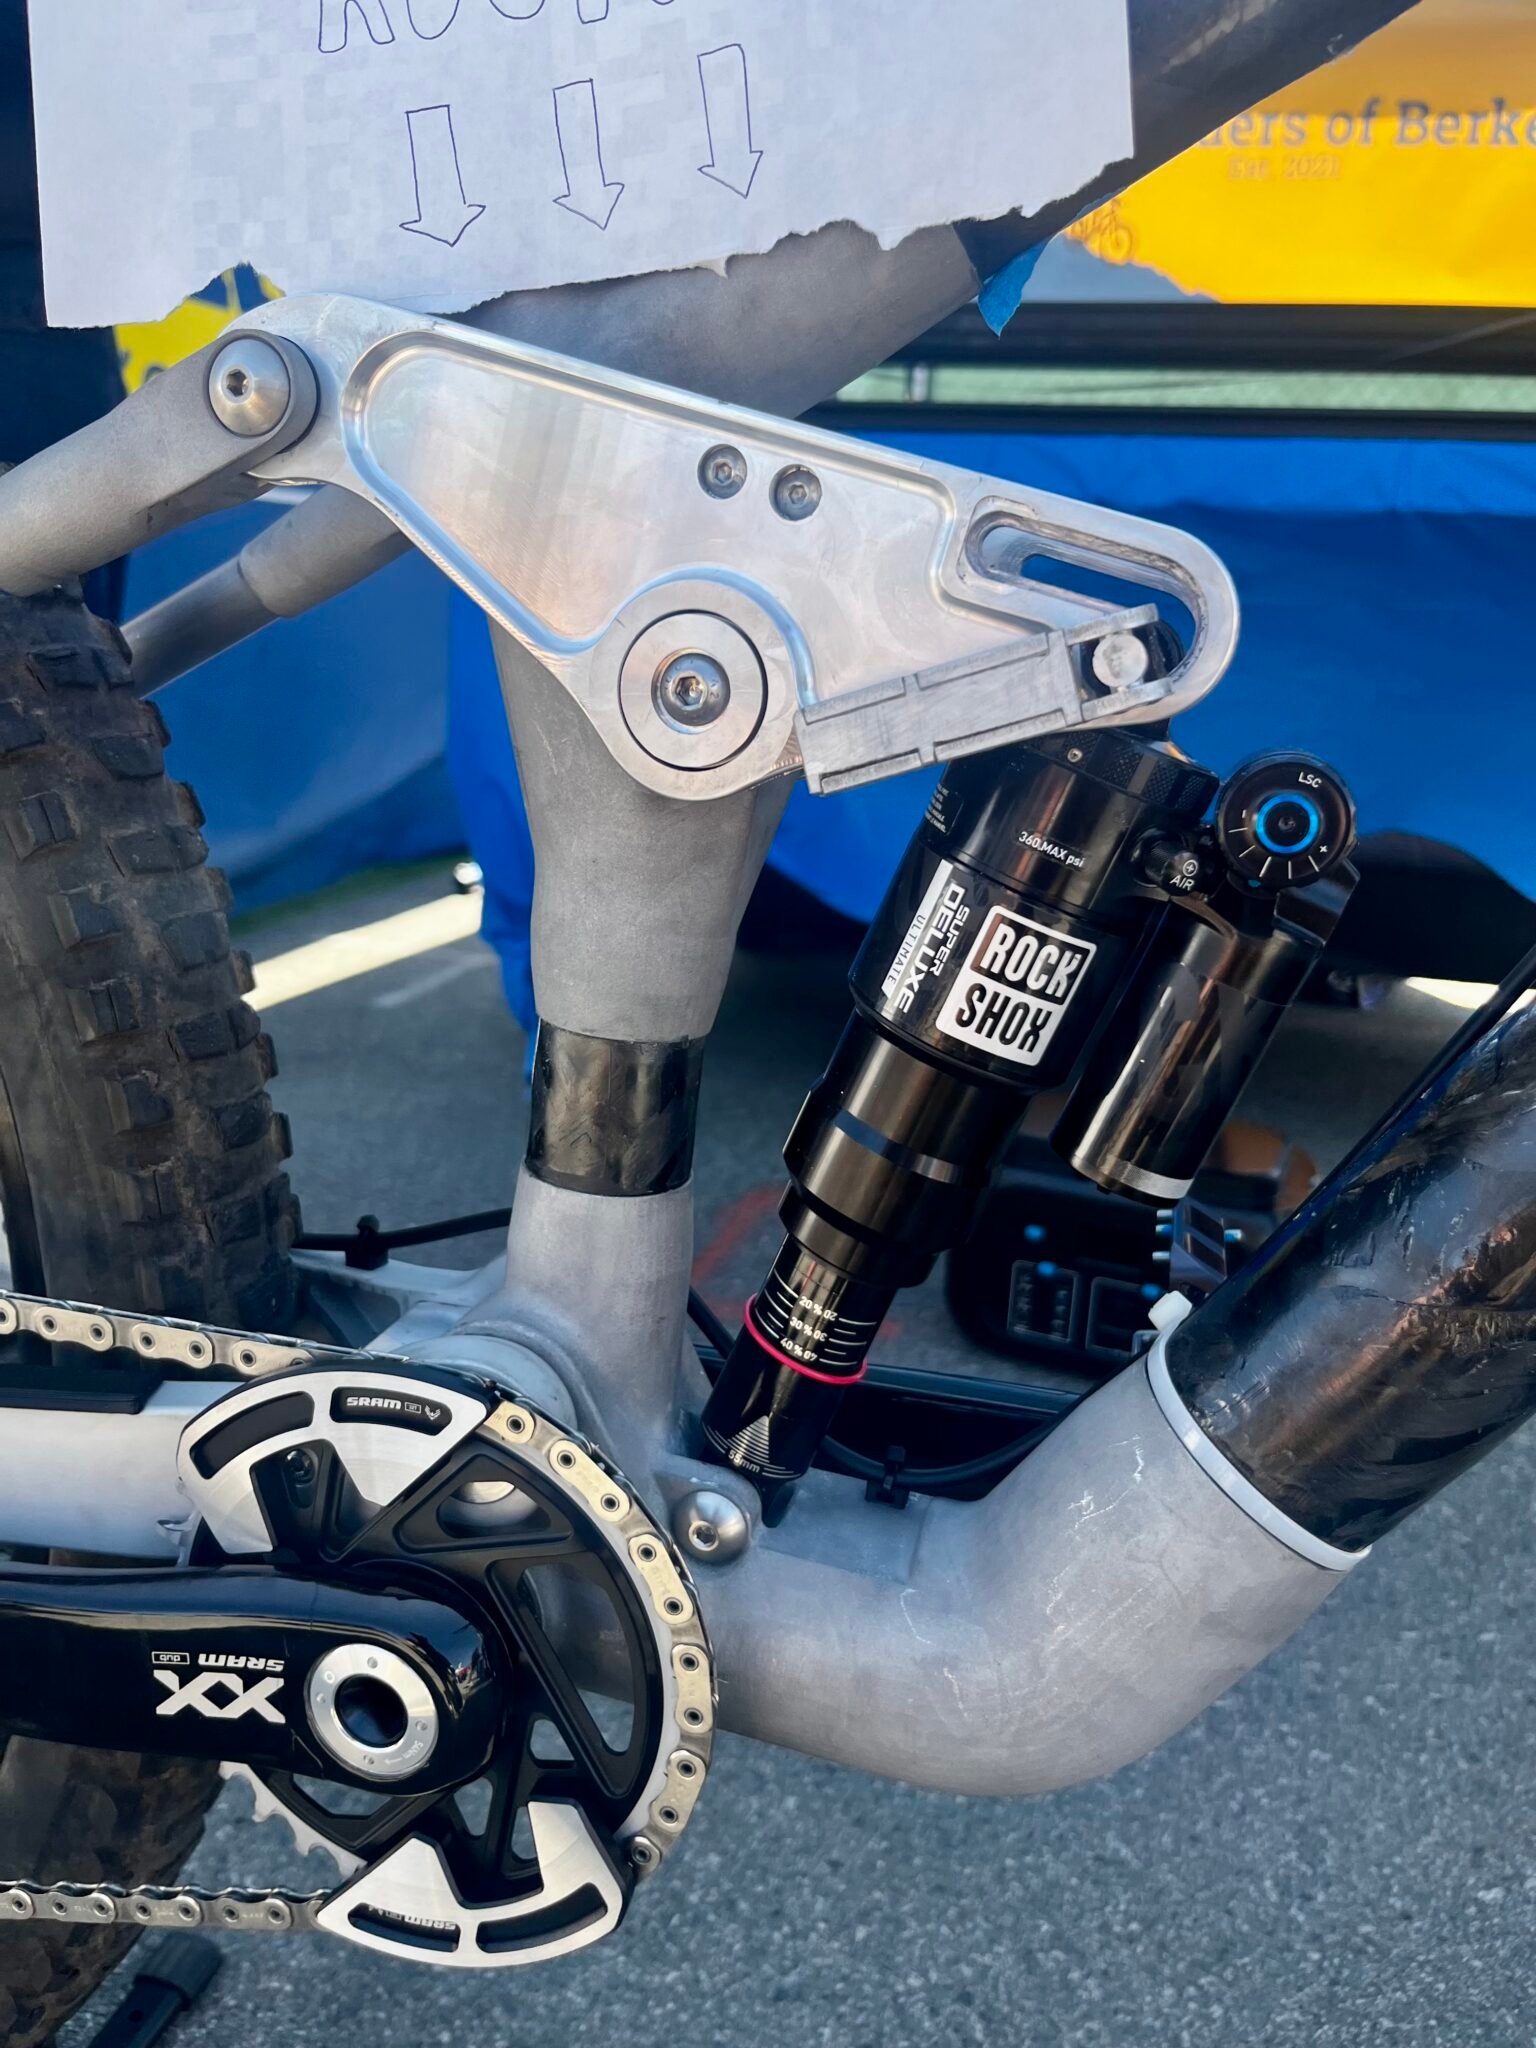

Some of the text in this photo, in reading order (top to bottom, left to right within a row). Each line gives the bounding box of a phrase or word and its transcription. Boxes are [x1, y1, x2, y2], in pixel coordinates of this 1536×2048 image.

[1325, 96, 1384, 147] of
[1298, 771, 1322, 788] LSC
[1065, 855, 1086, 868] psi
[1169, 875, 1195, 891] AIR
[887, 914, 926, 984] ULTIMATE
[895, 882, 966, 1013] DELUXE
[929, 904, 970, 976] SUPER
[979, 923, 1083, 998] ROCK
[955, 983, 1053, 1053] SHOX
[346, 1397, 401, 1410] SRAM
[728, 1450, 760, 1473] 55mm
[198, 1653, 285, 1672] SRAM
[153, 1669, 286, 1724] XX
